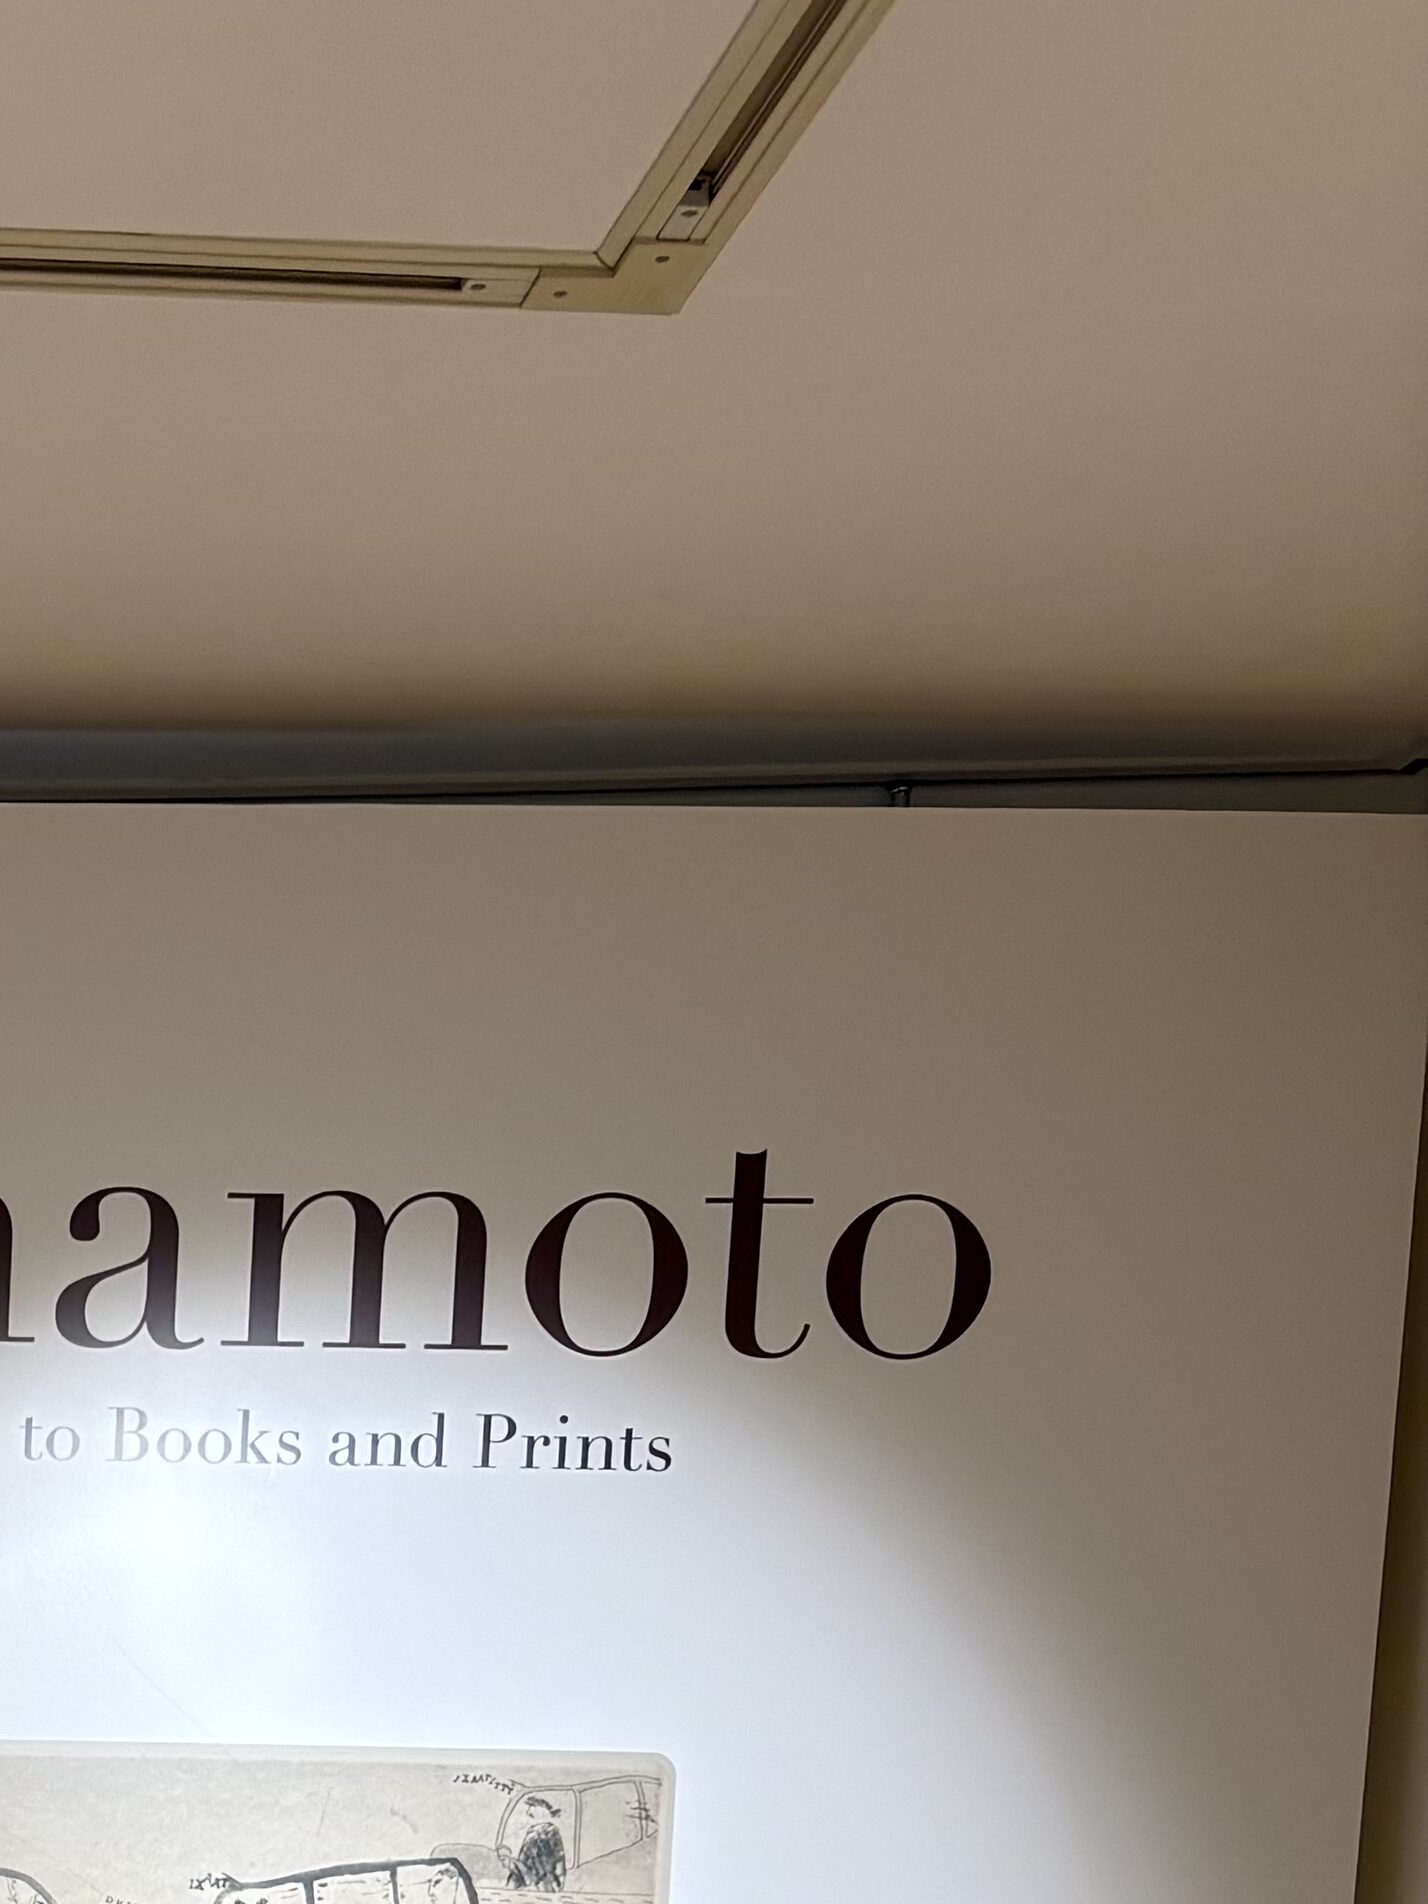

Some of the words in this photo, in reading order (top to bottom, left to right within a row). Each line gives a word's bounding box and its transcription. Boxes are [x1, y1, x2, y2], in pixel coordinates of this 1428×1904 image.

[20, 1416, 81, 1462] to
[106, 1406, 302, 1466] Books
[328, 1411, 449, 1469] and
[472, 1412, 672, 1473] Prints
